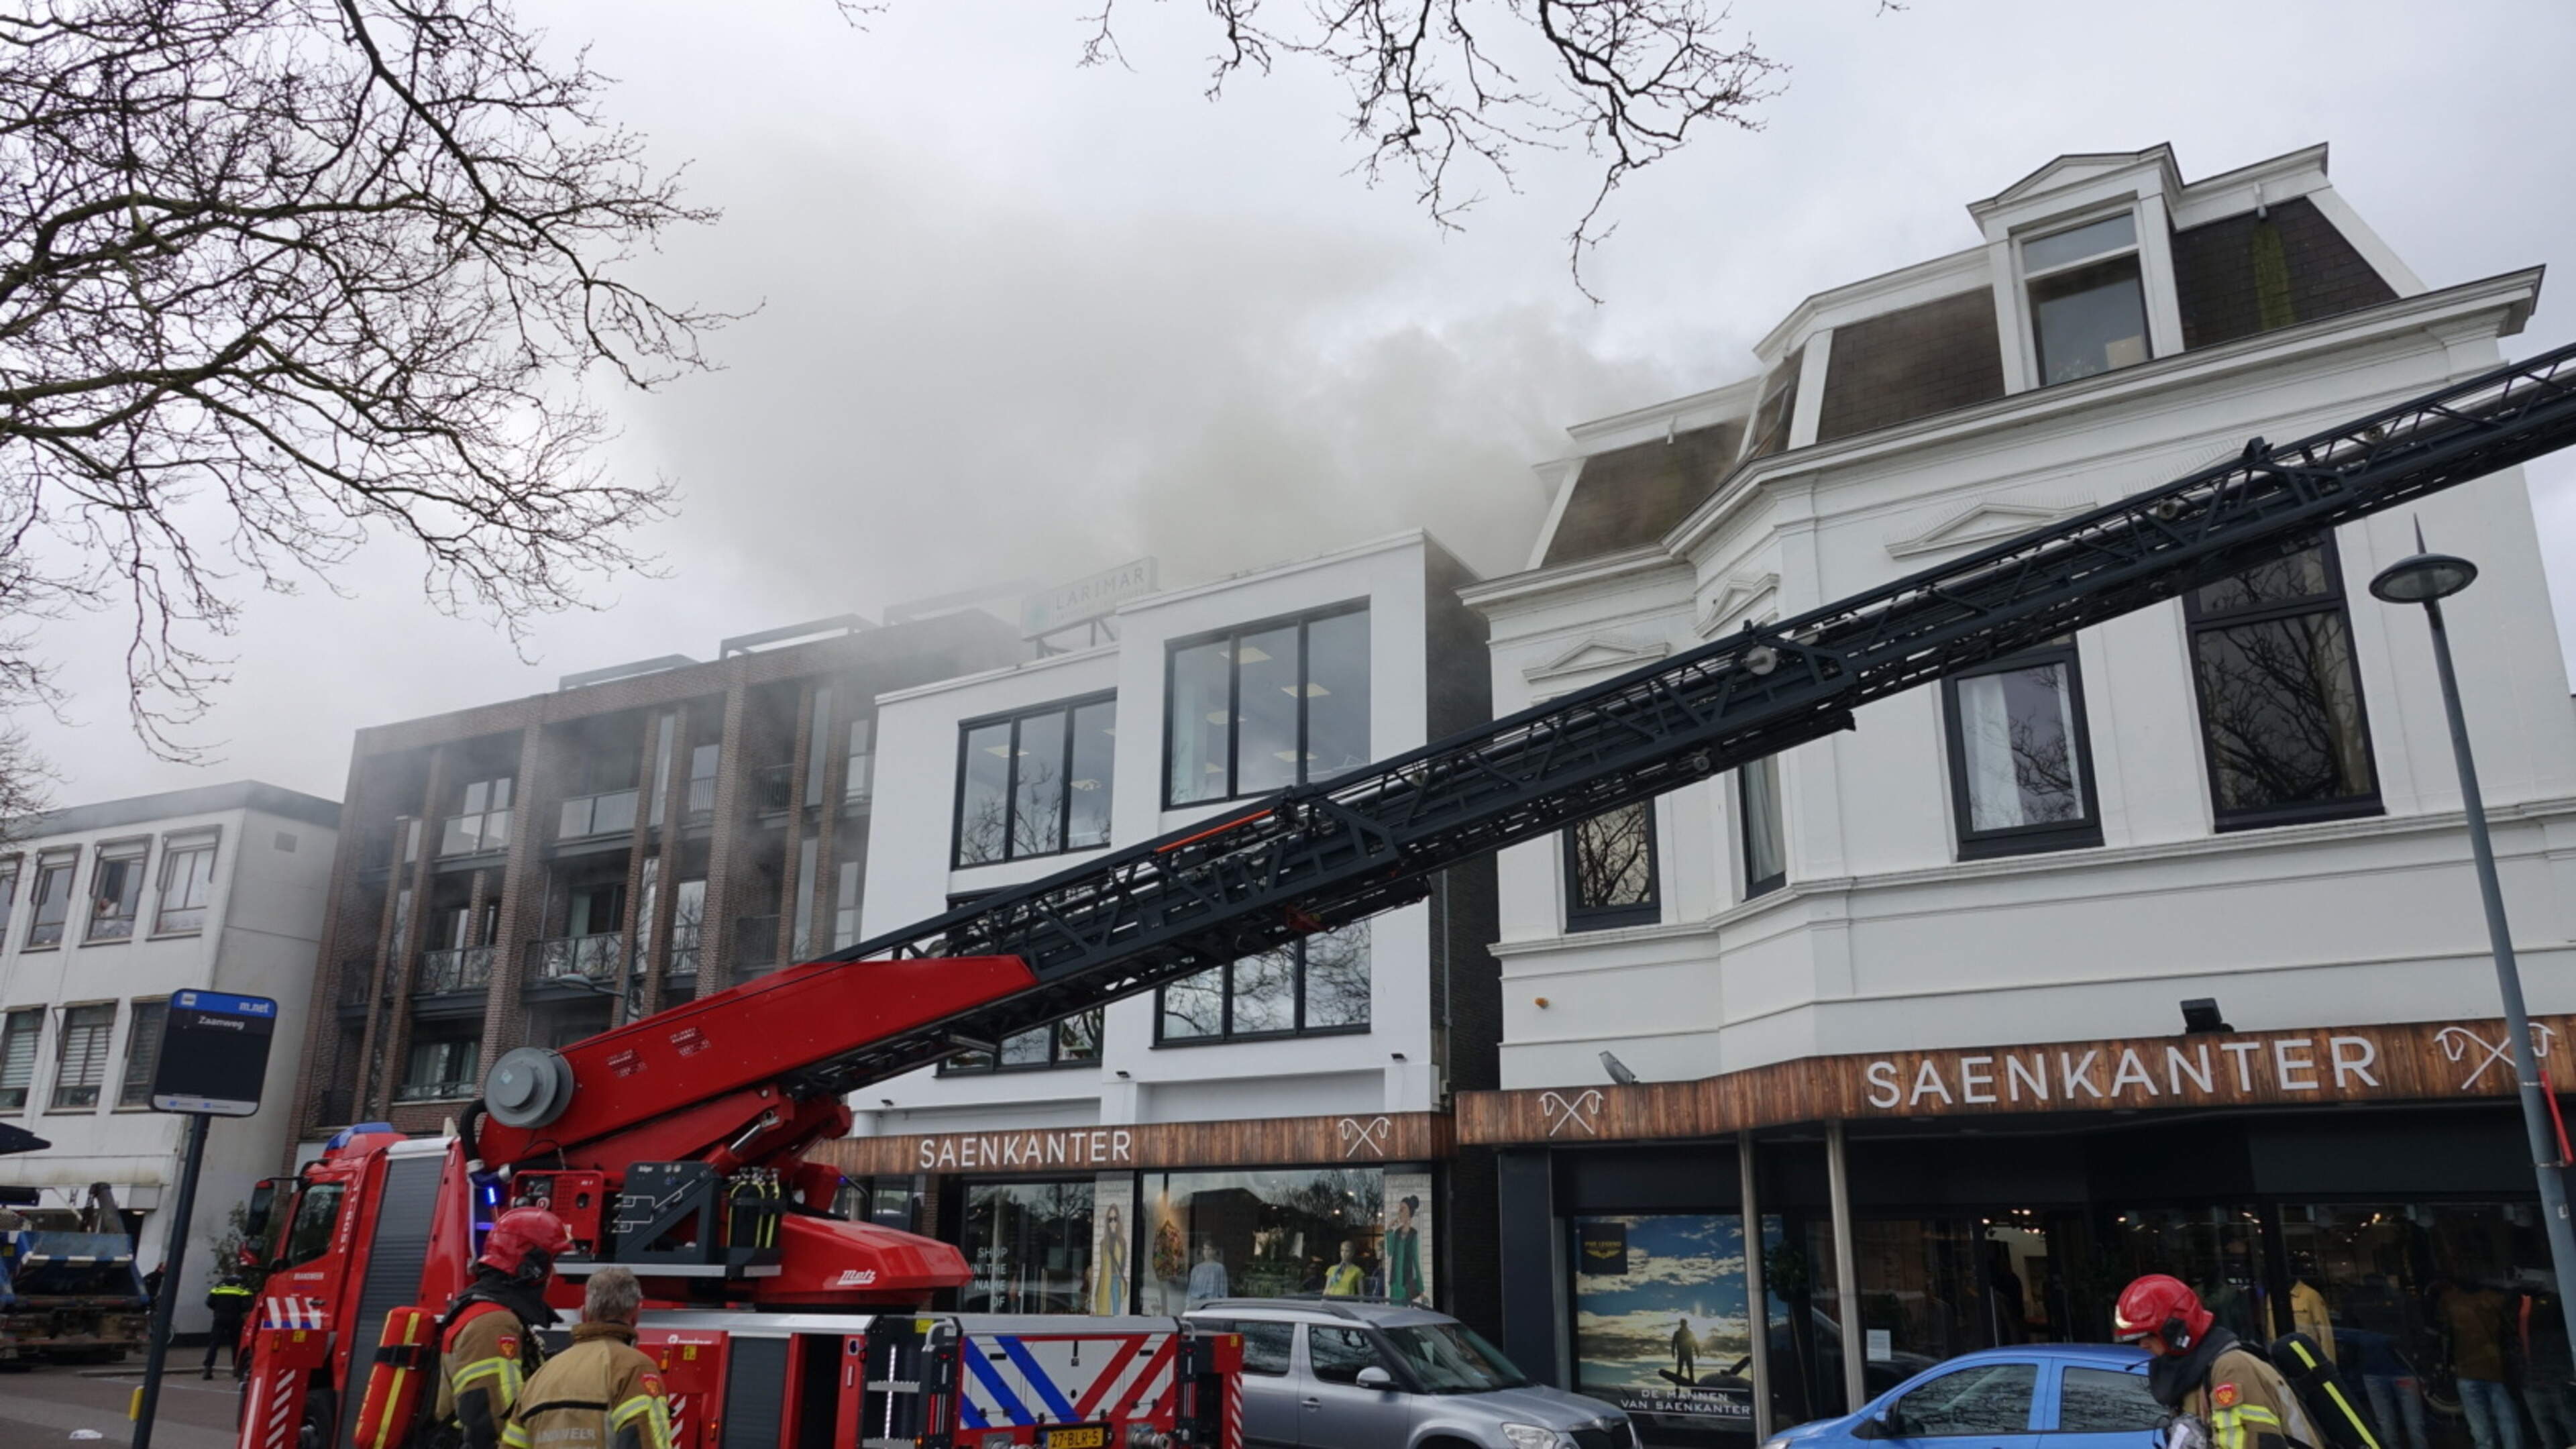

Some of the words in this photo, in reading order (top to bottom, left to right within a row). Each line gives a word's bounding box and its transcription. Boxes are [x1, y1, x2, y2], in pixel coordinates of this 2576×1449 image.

[1055, 567, 1144, 610] LARIMAR
[238, 1002, 270, 1014] m.net
[198, 1015, 246, 1031] Zaanweg
[1866, 1035, 2380, 1109] SAENKANTER
[920, 1130, 1131, 1169] SAENKANTER
[977, 1246, 1009, 1258] SHOP
[839, 1268, 876, 1284] Metz
[986, 1263, 1007, 1275] THE
[975, 1279, 1006, 1291] NAME
[992, 1295, 1006, 1308] OF
[1641, 1389, 1658, 1399] DE
[1666, 1389, 1729, 1401] MANNEN
[1621, 1399, 1648, 1409] VAN
[1656, 1400, 1751, 1415] SAENKANTER
[1051, 1430, 1099, 1448] 27-BLR-5
